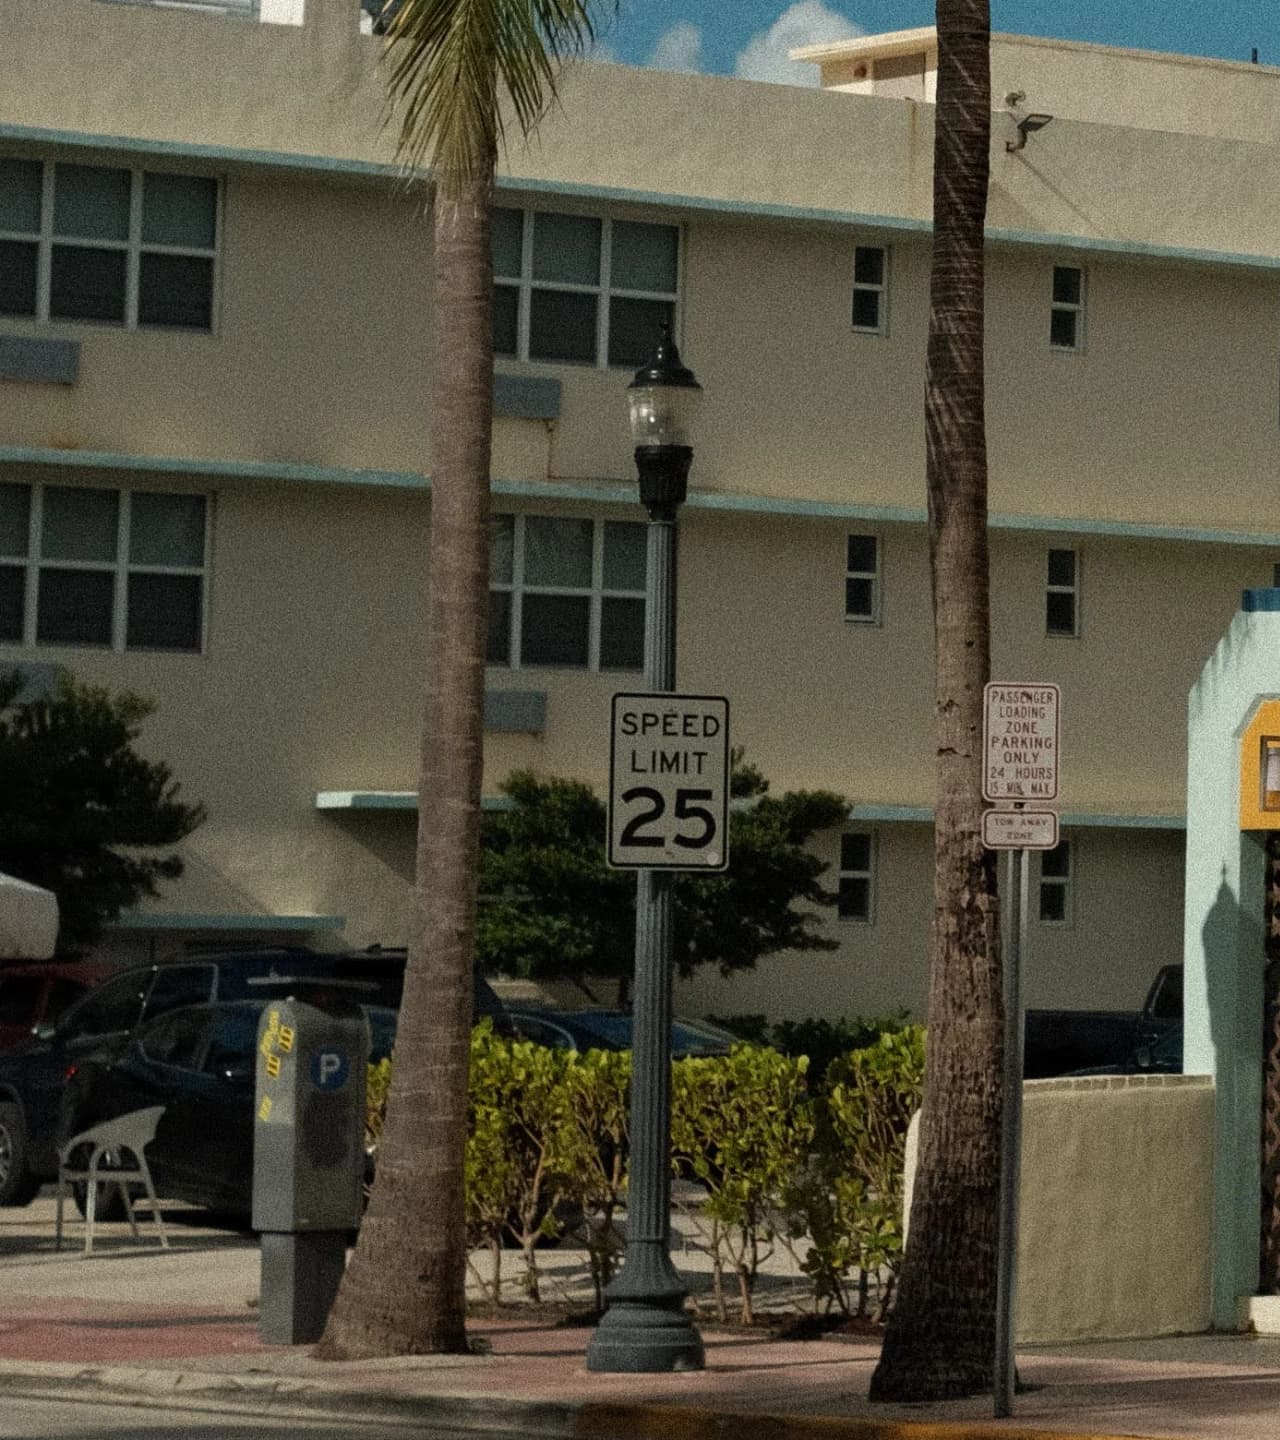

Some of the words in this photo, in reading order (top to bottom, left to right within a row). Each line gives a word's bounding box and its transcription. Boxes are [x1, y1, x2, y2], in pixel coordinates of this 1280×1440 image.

[991, 690, 1053, 705] PASSENGER
[999, 706, 1046, 719] LOADING
[621, 712, 720, 738] SPEED
[1006, 720, 1038, 734] ZONE
[991, 735, 1052, 750] PARKING
[631, 749, 708, 775] LIMIT
[1003, 750, 1040, 764] ONLY
[990, 766, 1004, 779] 24
[1015, 767, 1053, 780] HOURS
[1030, 781, 1050, 794] MAX
[619, 786, 717, 849] 25
[320, 1053, 341, 1084] P
